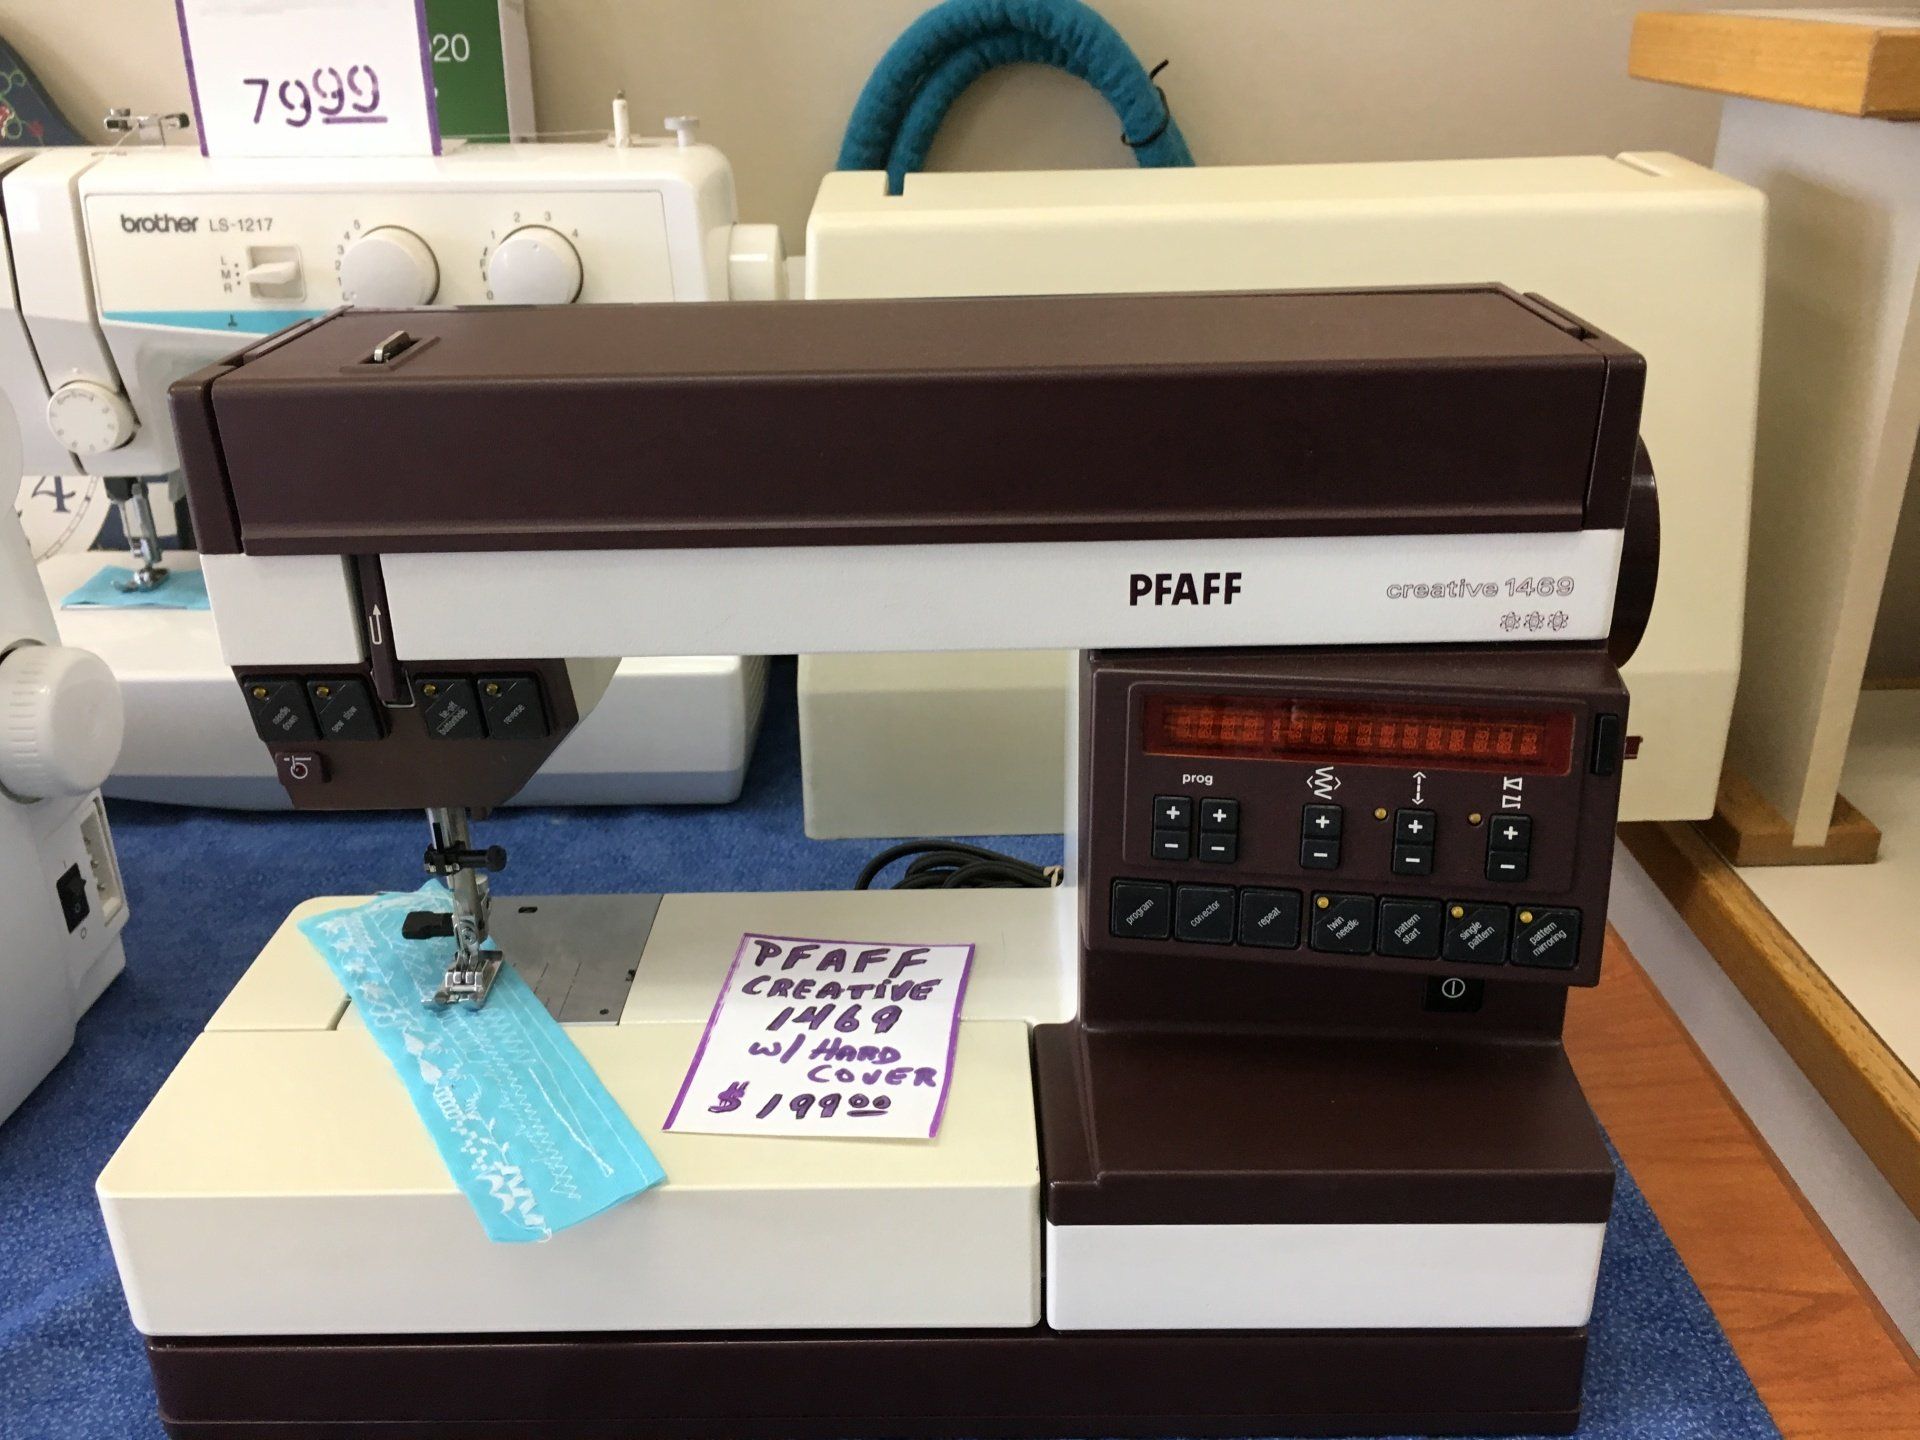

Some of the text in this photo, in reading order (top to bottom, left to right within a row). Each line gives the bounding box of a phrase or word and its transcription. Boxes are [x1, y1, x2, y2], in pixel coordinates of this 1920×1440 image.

[429, 33, 469, 62] 20
[120, 214, 273, 233] brother LS-1217
[1129, 572, 1242, 606] PFAFF
[1386, 576, 1575, 599] creative 1469
[1182, 773, 1214, 786] prog
[1125, 898, 1154, 926] program
[1257, 906, 1282, 928] repeat
[1326, 915, 1345, 932] twin
[1335, 918, 1360, 940] needle
[1394, 913, 1421, 938] pattern
[1402, 927, 1421, 945] start
[1459, 921, 1483, 941] single
[1529, 921, 1558, 946] pattern
[1467, 926, 1496, 950] pattern
[1532, 929, 1568, 957] mirroring
[753, 939, 930, 978] PFAFF
[766, 1003, 903, 1034] 1469
[807, 1064, 937, 1087] COVER
